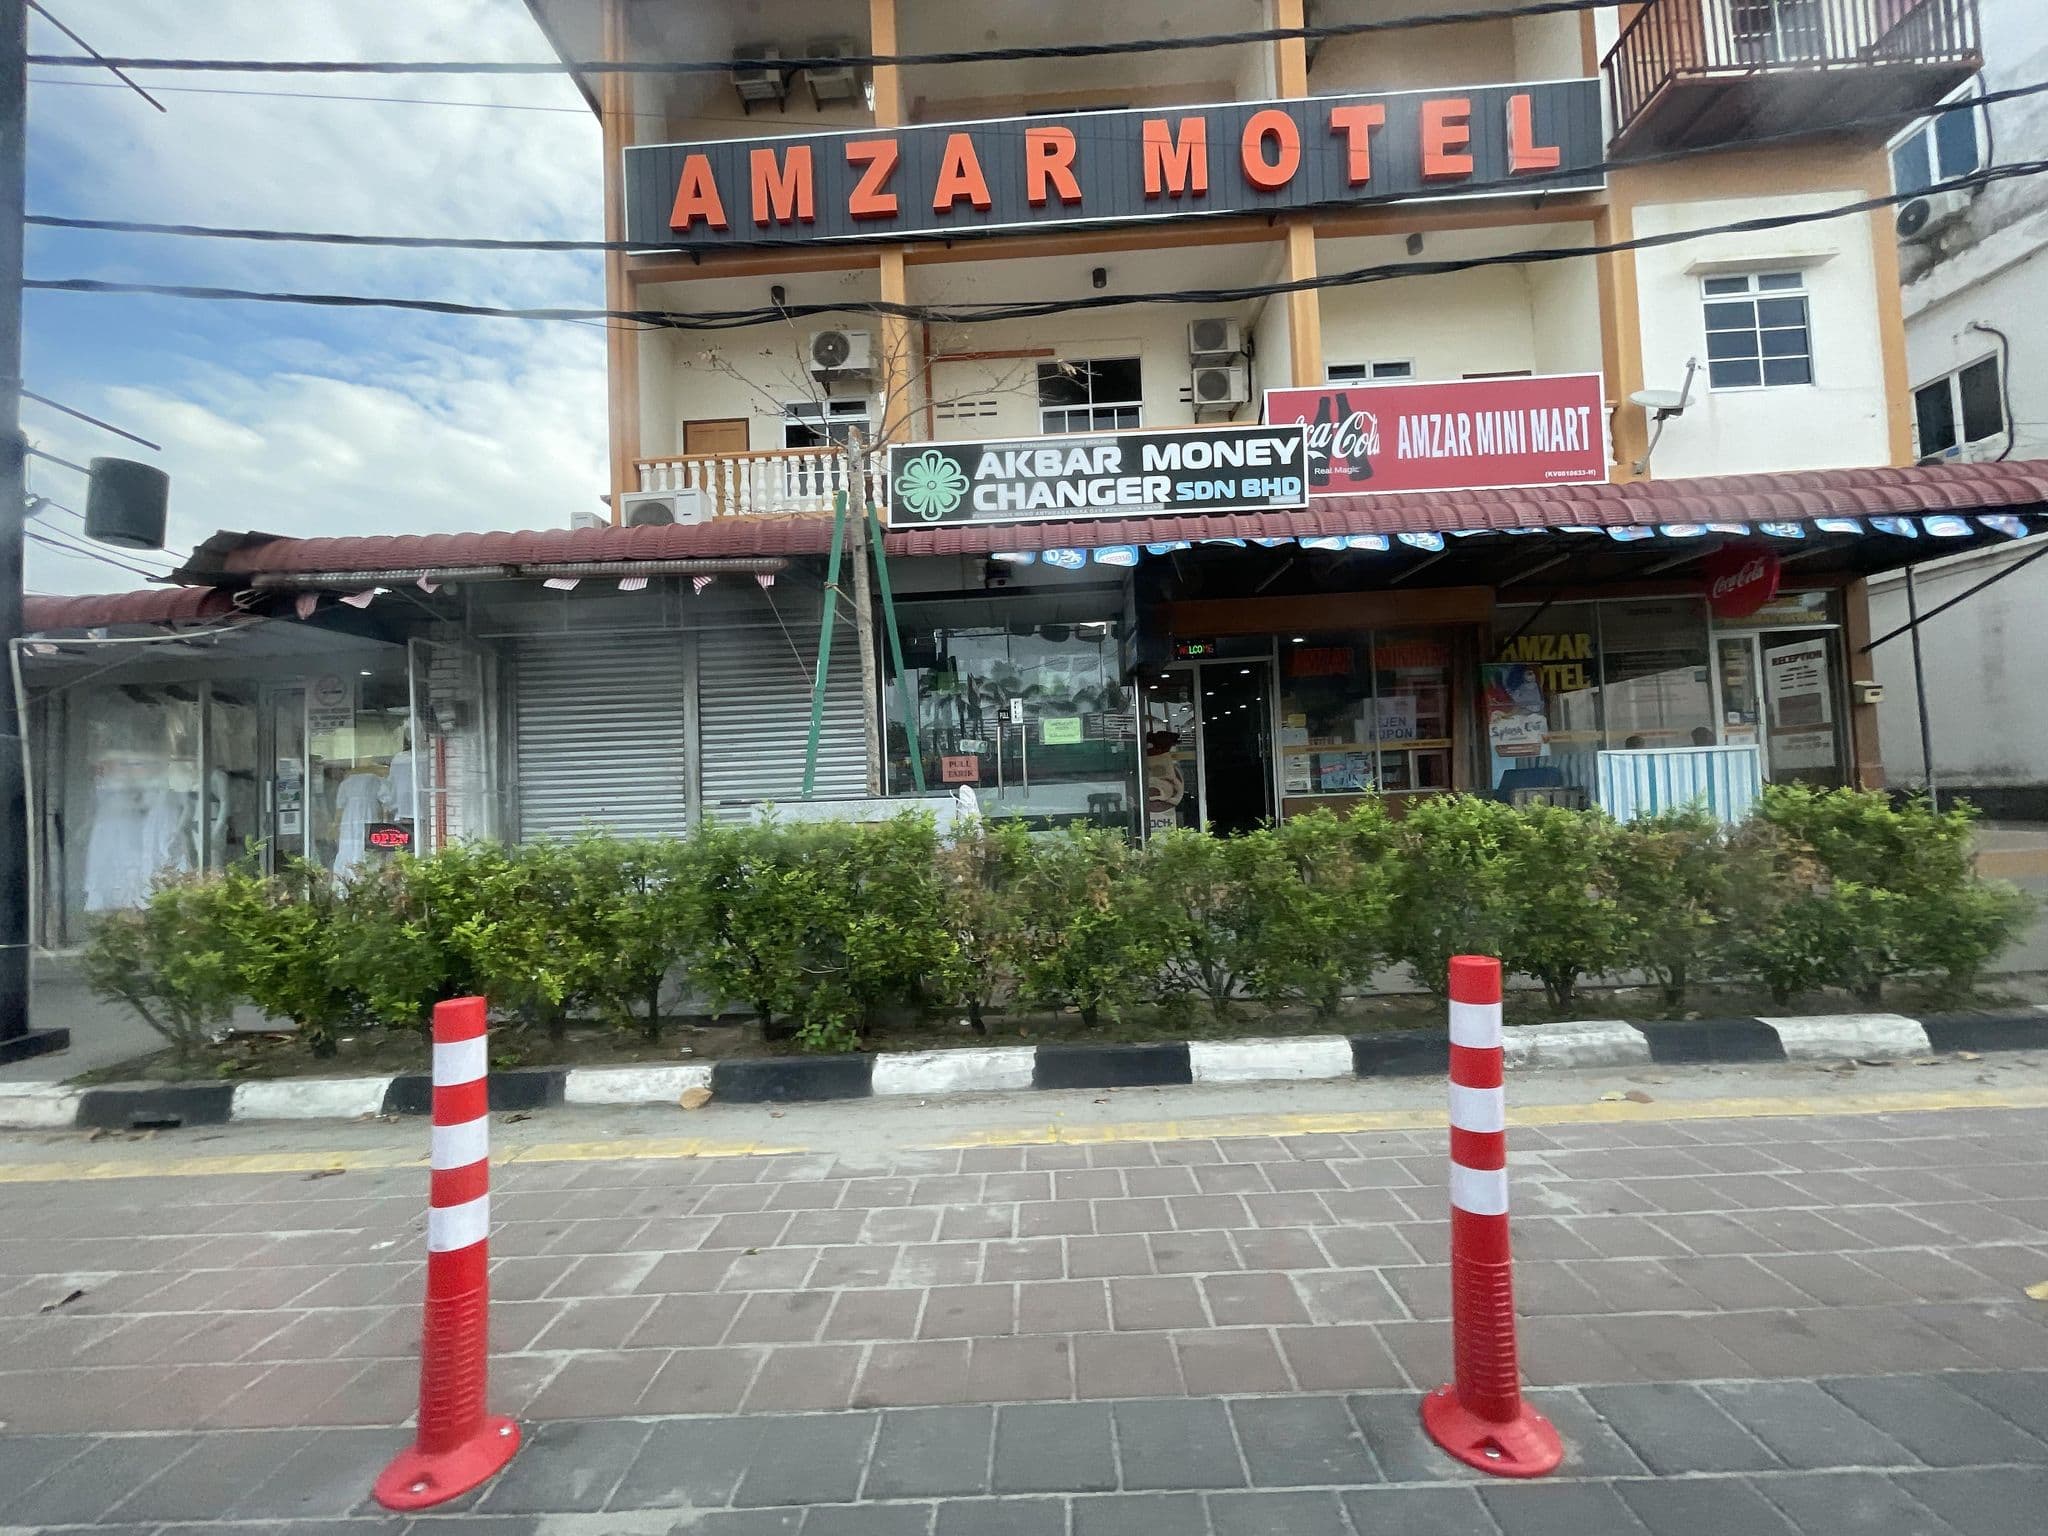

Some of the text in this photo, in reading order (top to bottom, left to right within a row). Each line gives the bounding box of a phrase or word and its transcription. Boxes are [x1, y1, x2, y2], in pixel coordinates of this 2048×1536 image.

[668, 92, 1562, 232] AMZAR MOTEL
[1397, 405, 1591, 460] AMZAR MINI MART
[973, 436, 1301, 480] AKBAR MONEY
[1314, 465, 1362, 476] Real Magic
[971, 476, 1301, 512] CHANGER SDN BHD
[1501, 633, 1594, 661] AMZAR
[1771, 649, 1823, 666] RECEPTION
